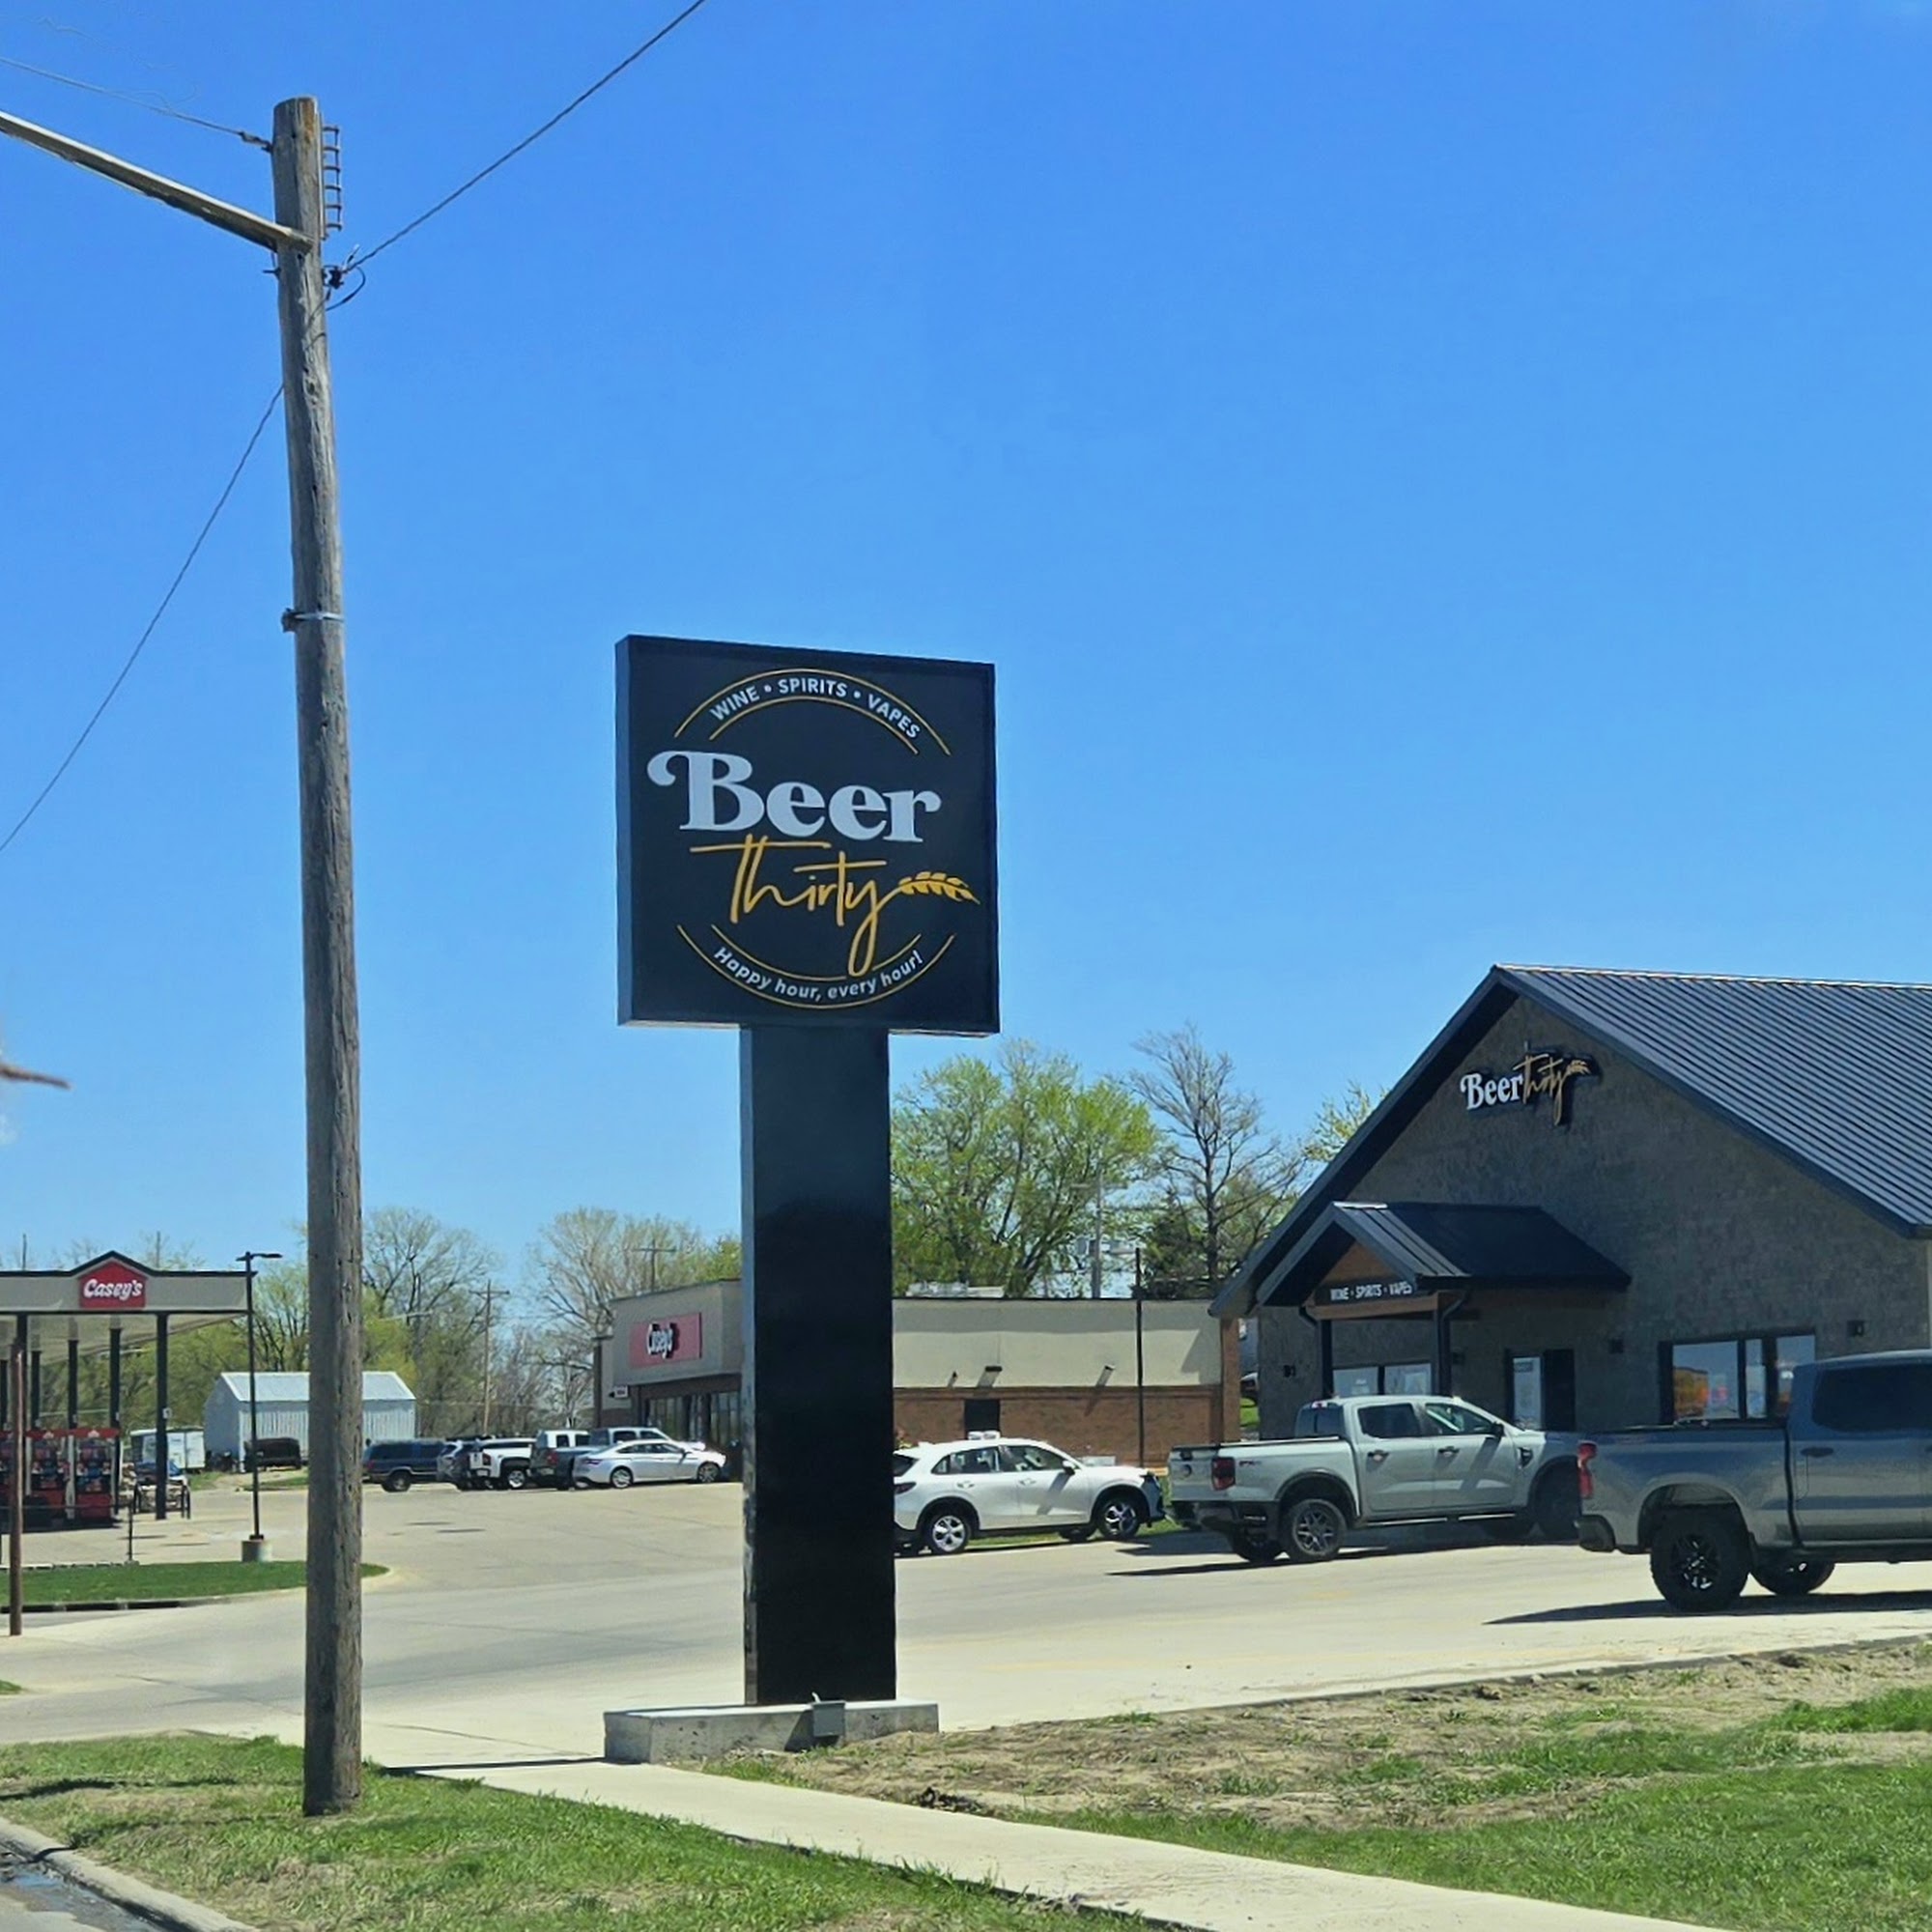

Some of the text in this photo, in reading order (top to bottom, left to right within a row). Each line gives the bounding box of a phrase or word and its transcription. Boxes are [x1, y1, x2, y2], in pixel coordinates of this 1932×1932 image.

[709, 677, 921, 738] WINE SPIRITS VAPES
[646, 750, 942, 843] Beer
[689, 833, 900, 978] Thirty
[714, 947, 923, 1002] Happy hour, every hour!
[1460, 1072, 1523, 1110] Beer
[83, 1278, 143, 1301] Casey's
